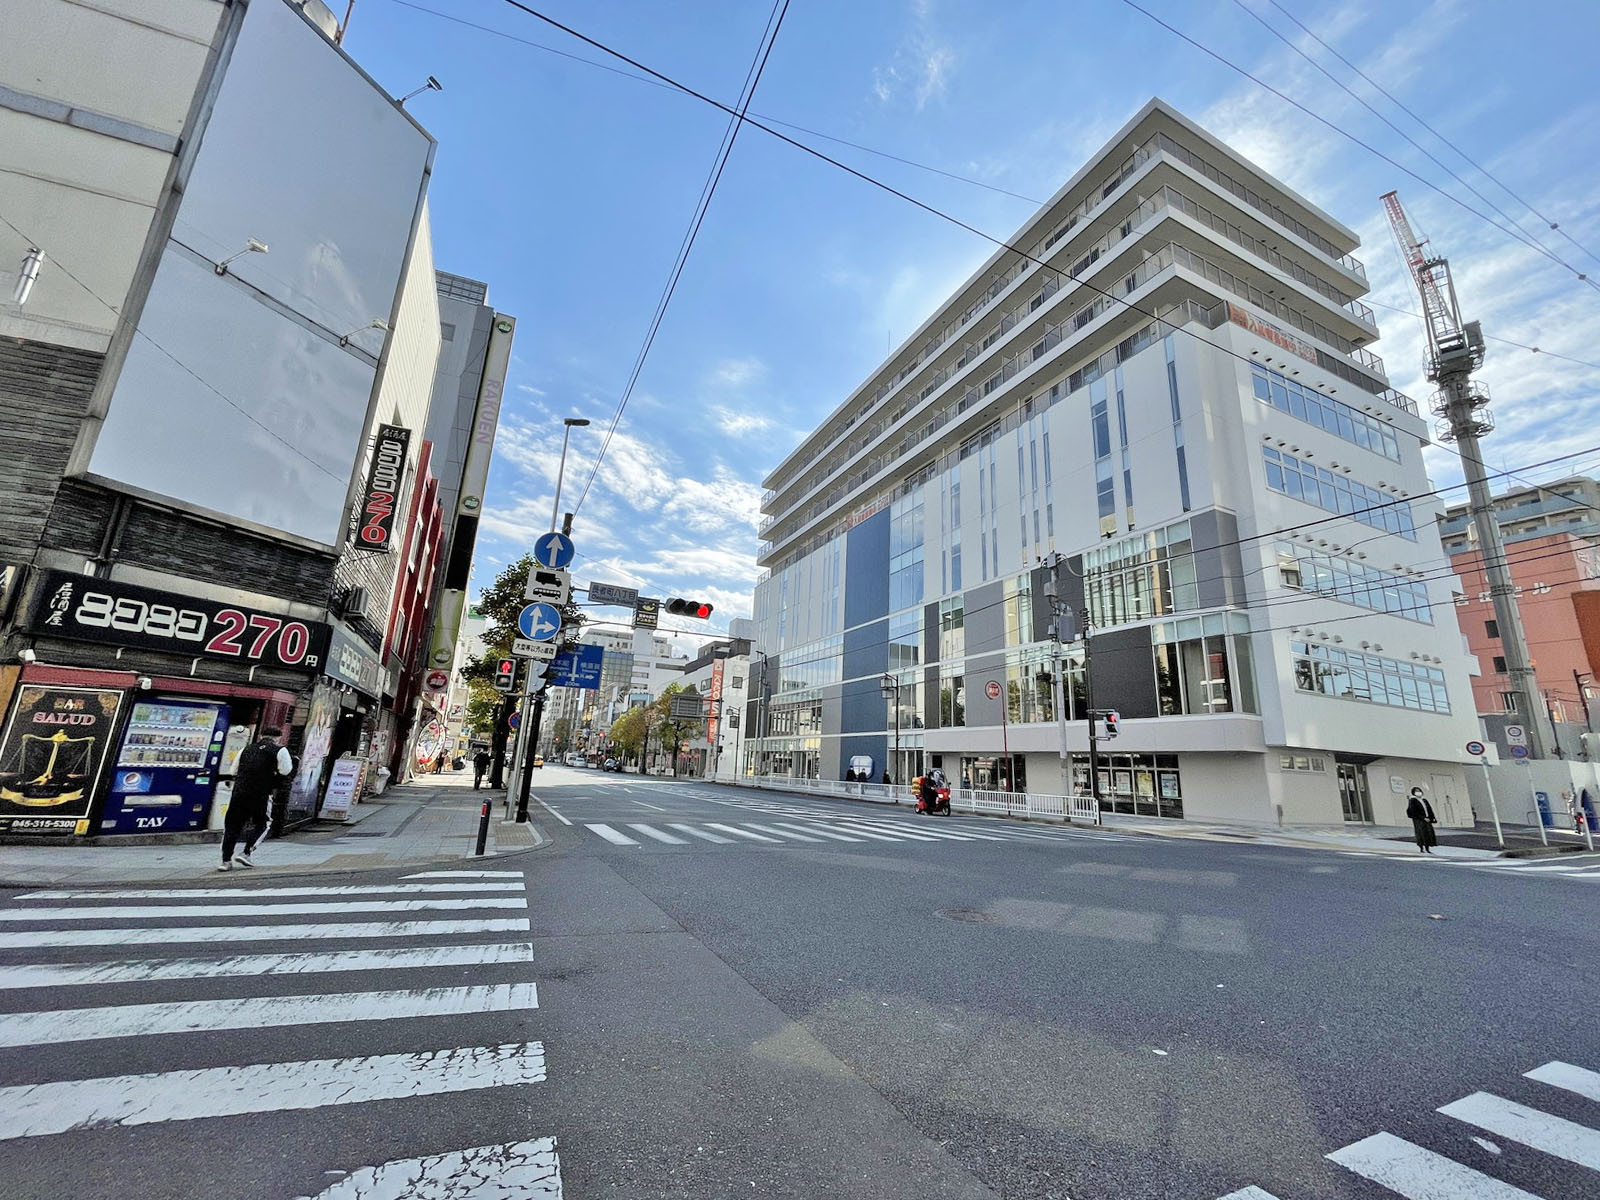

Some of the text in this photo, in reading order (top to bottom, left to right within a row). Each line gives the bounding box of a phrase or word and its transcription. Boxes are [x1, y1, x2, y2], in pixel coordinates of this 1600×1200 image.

[476, 379, 502, 445] RAKUEN
[361, 491, 395, 544] 270
[45, 581, 74, 627] 居酒屋
[205, 608, 310, 665] 270
[305, 654, 318, 667] 円
[32, 711, 97, 726] SALUD
[11, 819, 76, 828] 045-315-5300
